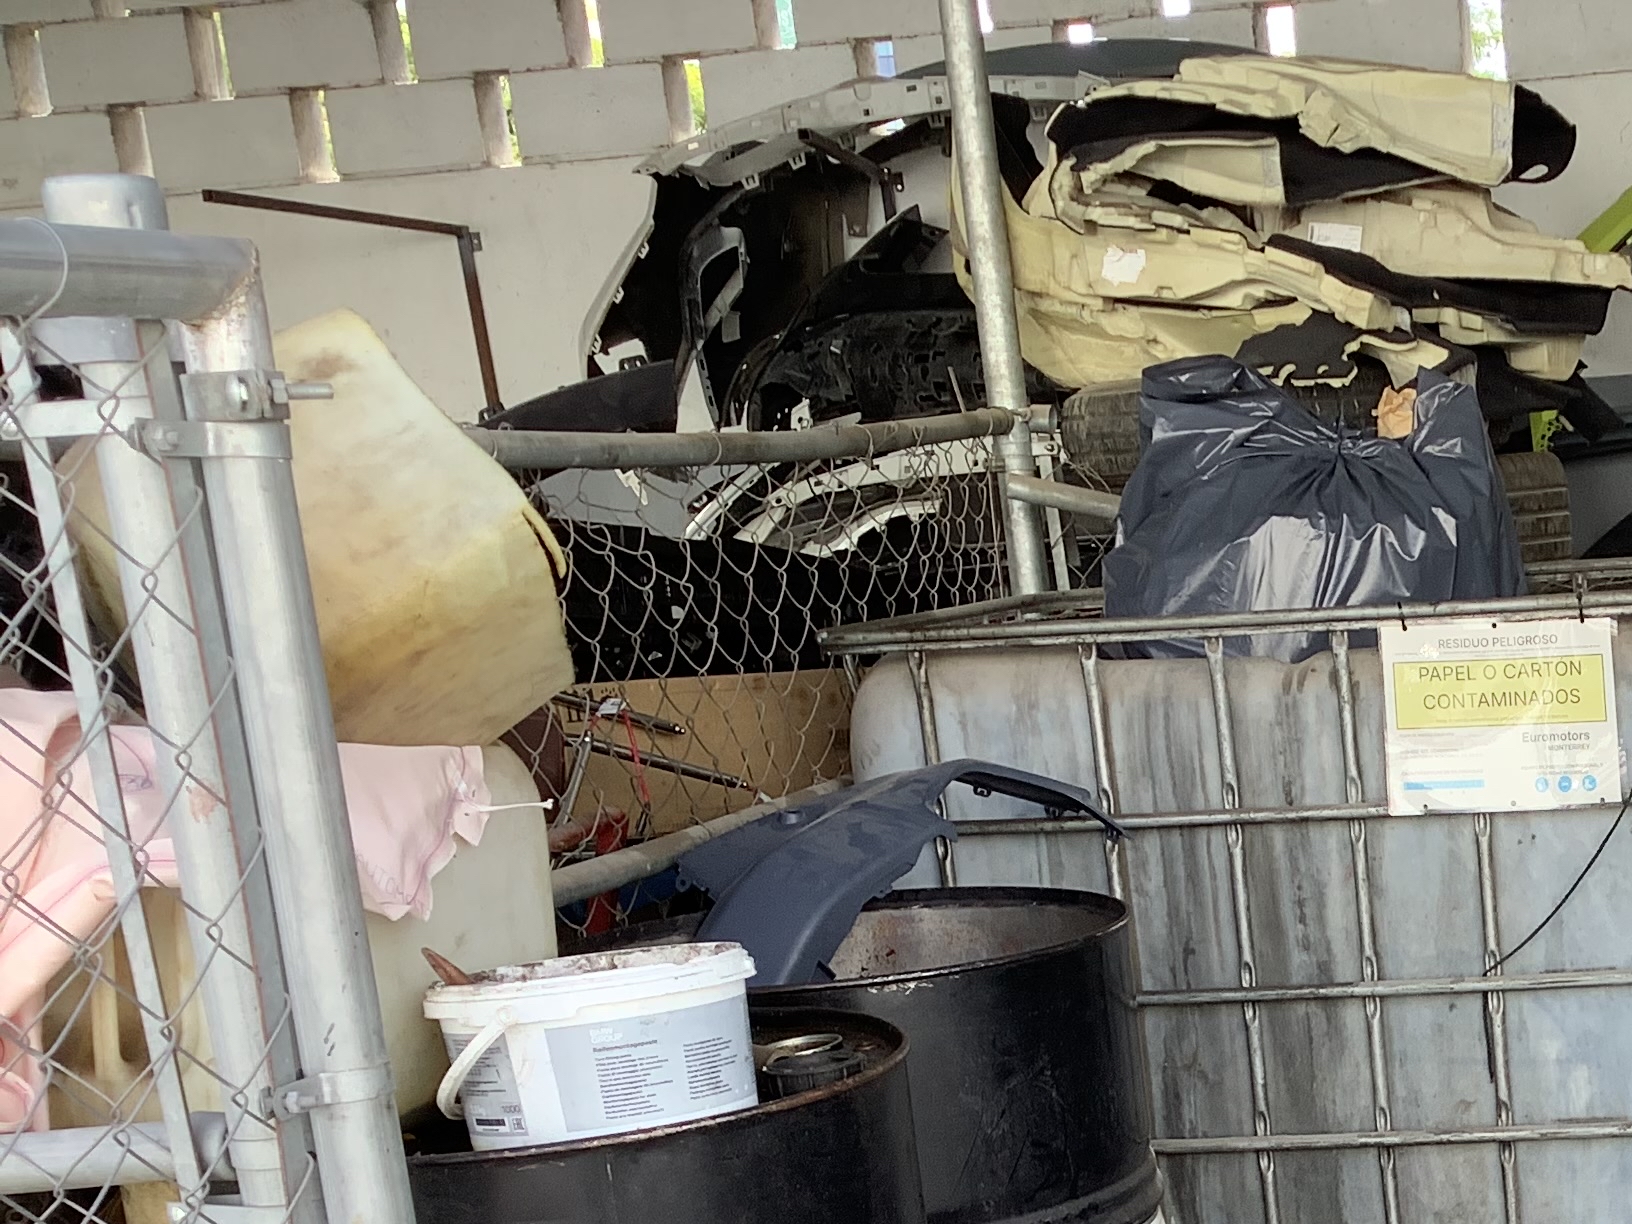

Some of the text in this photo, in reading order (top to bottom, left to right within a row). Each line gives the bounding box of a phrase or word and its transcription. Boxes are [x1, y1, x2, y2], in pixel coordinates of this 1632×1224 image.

[1438, 634, 1558, 649] RESIDUO PELIGROSO
[1419, 657, 1582, 682] PAPEL O CARTÓN
[1423, 688, 1581, 710] CONTAMINADOS
[1522, 731, 1590, 742] Euromotors
